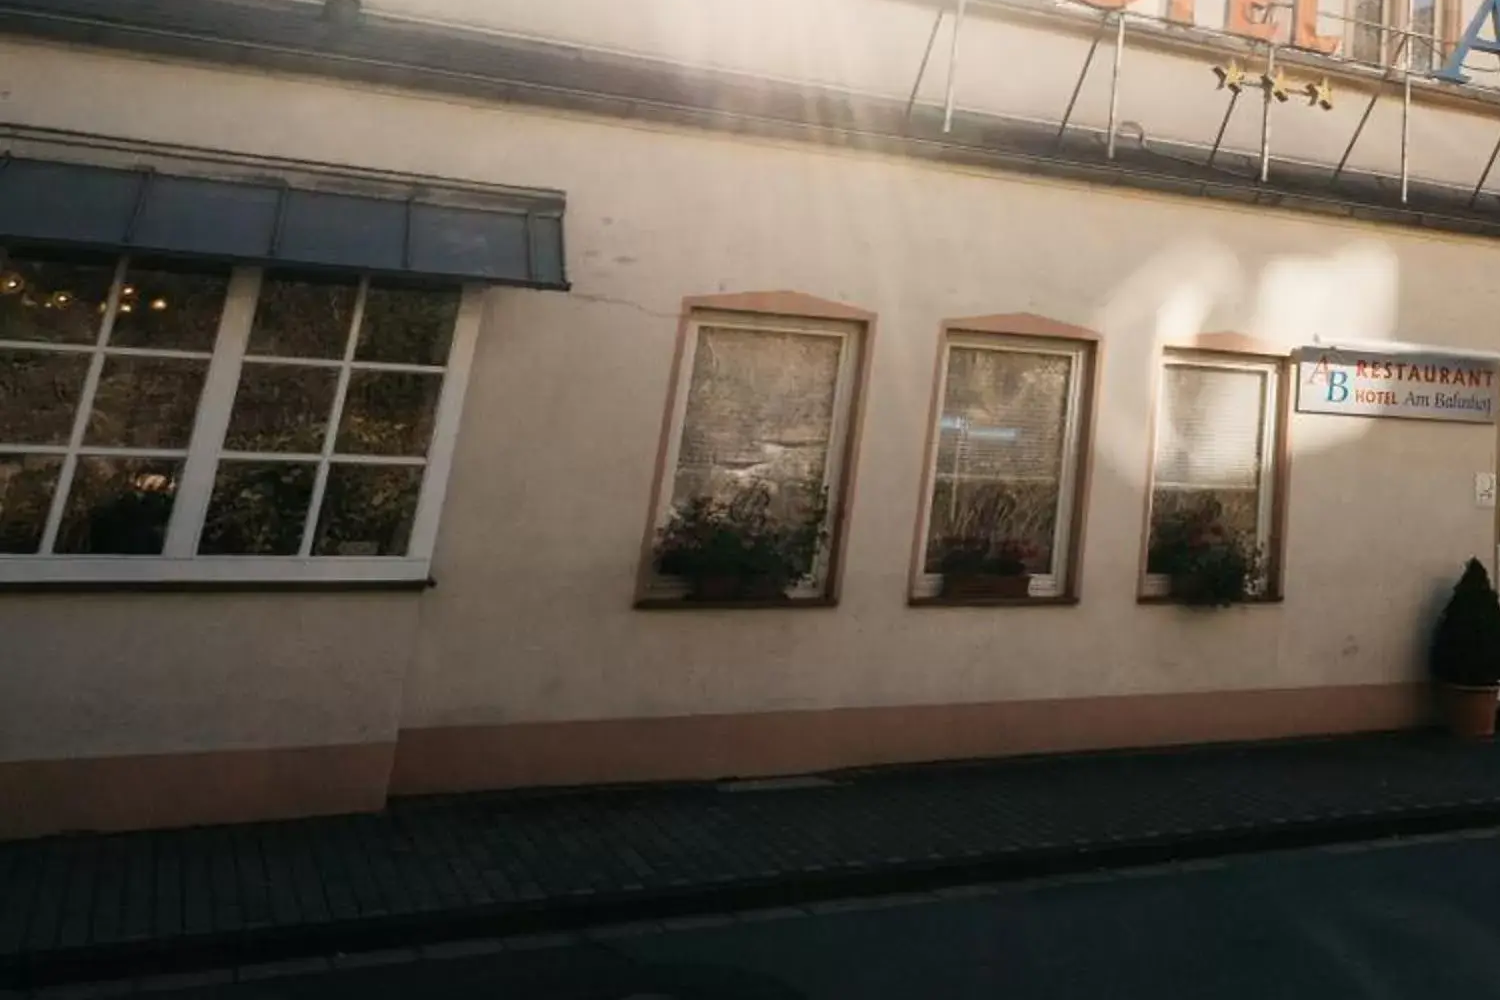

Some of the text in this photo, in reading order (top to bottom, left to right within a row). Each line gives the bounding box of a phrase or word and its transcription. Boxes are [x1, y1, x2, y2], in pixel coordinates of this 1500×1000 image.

[1356, 359, 1494, 387] RESTAURANT
[1355, 390, 1398, 406] HOTEL
[1403, 391, 1430, 408] Am
